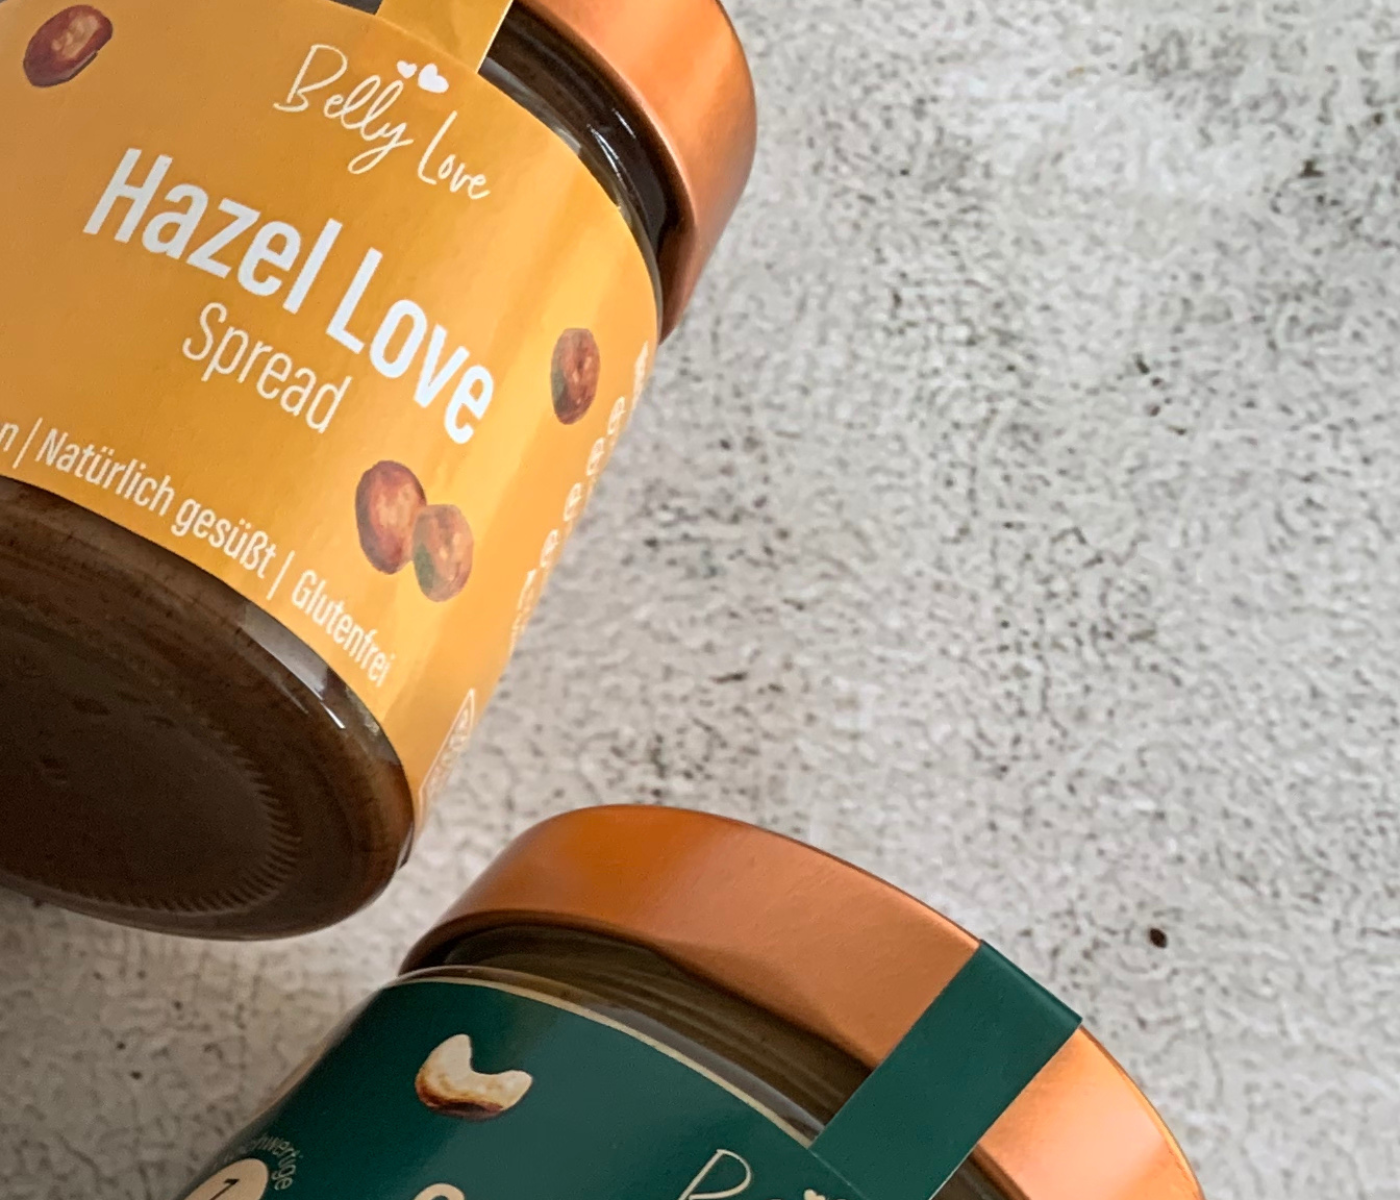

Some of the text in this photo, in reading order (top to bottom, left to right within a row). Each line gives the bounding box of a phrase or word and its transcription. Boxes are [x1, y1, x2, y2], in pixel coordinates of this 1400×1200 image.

[273, 44, 491, 200] Belly Love
[83, 147, 494, 444] Hazel Love
[182, 301, 352, 433] Spread
[35, 428, 176, 515] Natürlich
[171, 498, 277, 579] gesüßt
[291, 569, 396, 687] Glutenfrei
